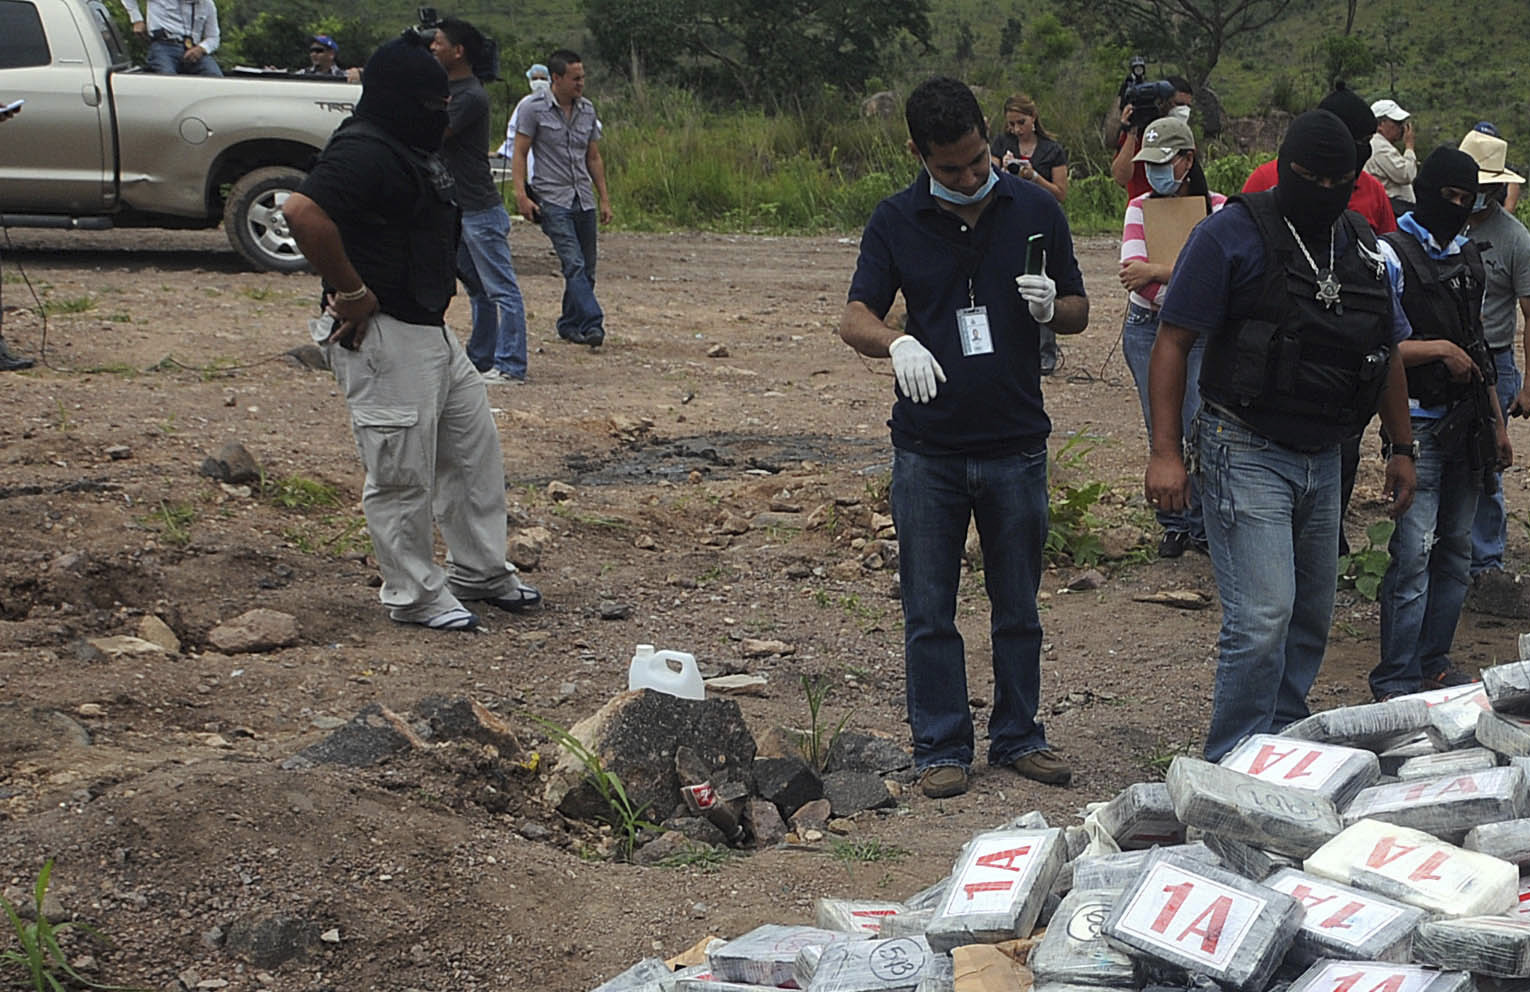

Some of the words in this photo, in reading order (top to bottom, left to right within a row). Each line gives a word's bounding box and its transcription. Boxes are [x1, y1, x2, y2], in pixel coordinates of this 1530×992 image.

[1248, 744, 1323, 780] 1A
[963, 845, 1032, 900] 1A
[1365, 836, 1452, 882] 1A
[1150, 881, 1234, 956] 1A
